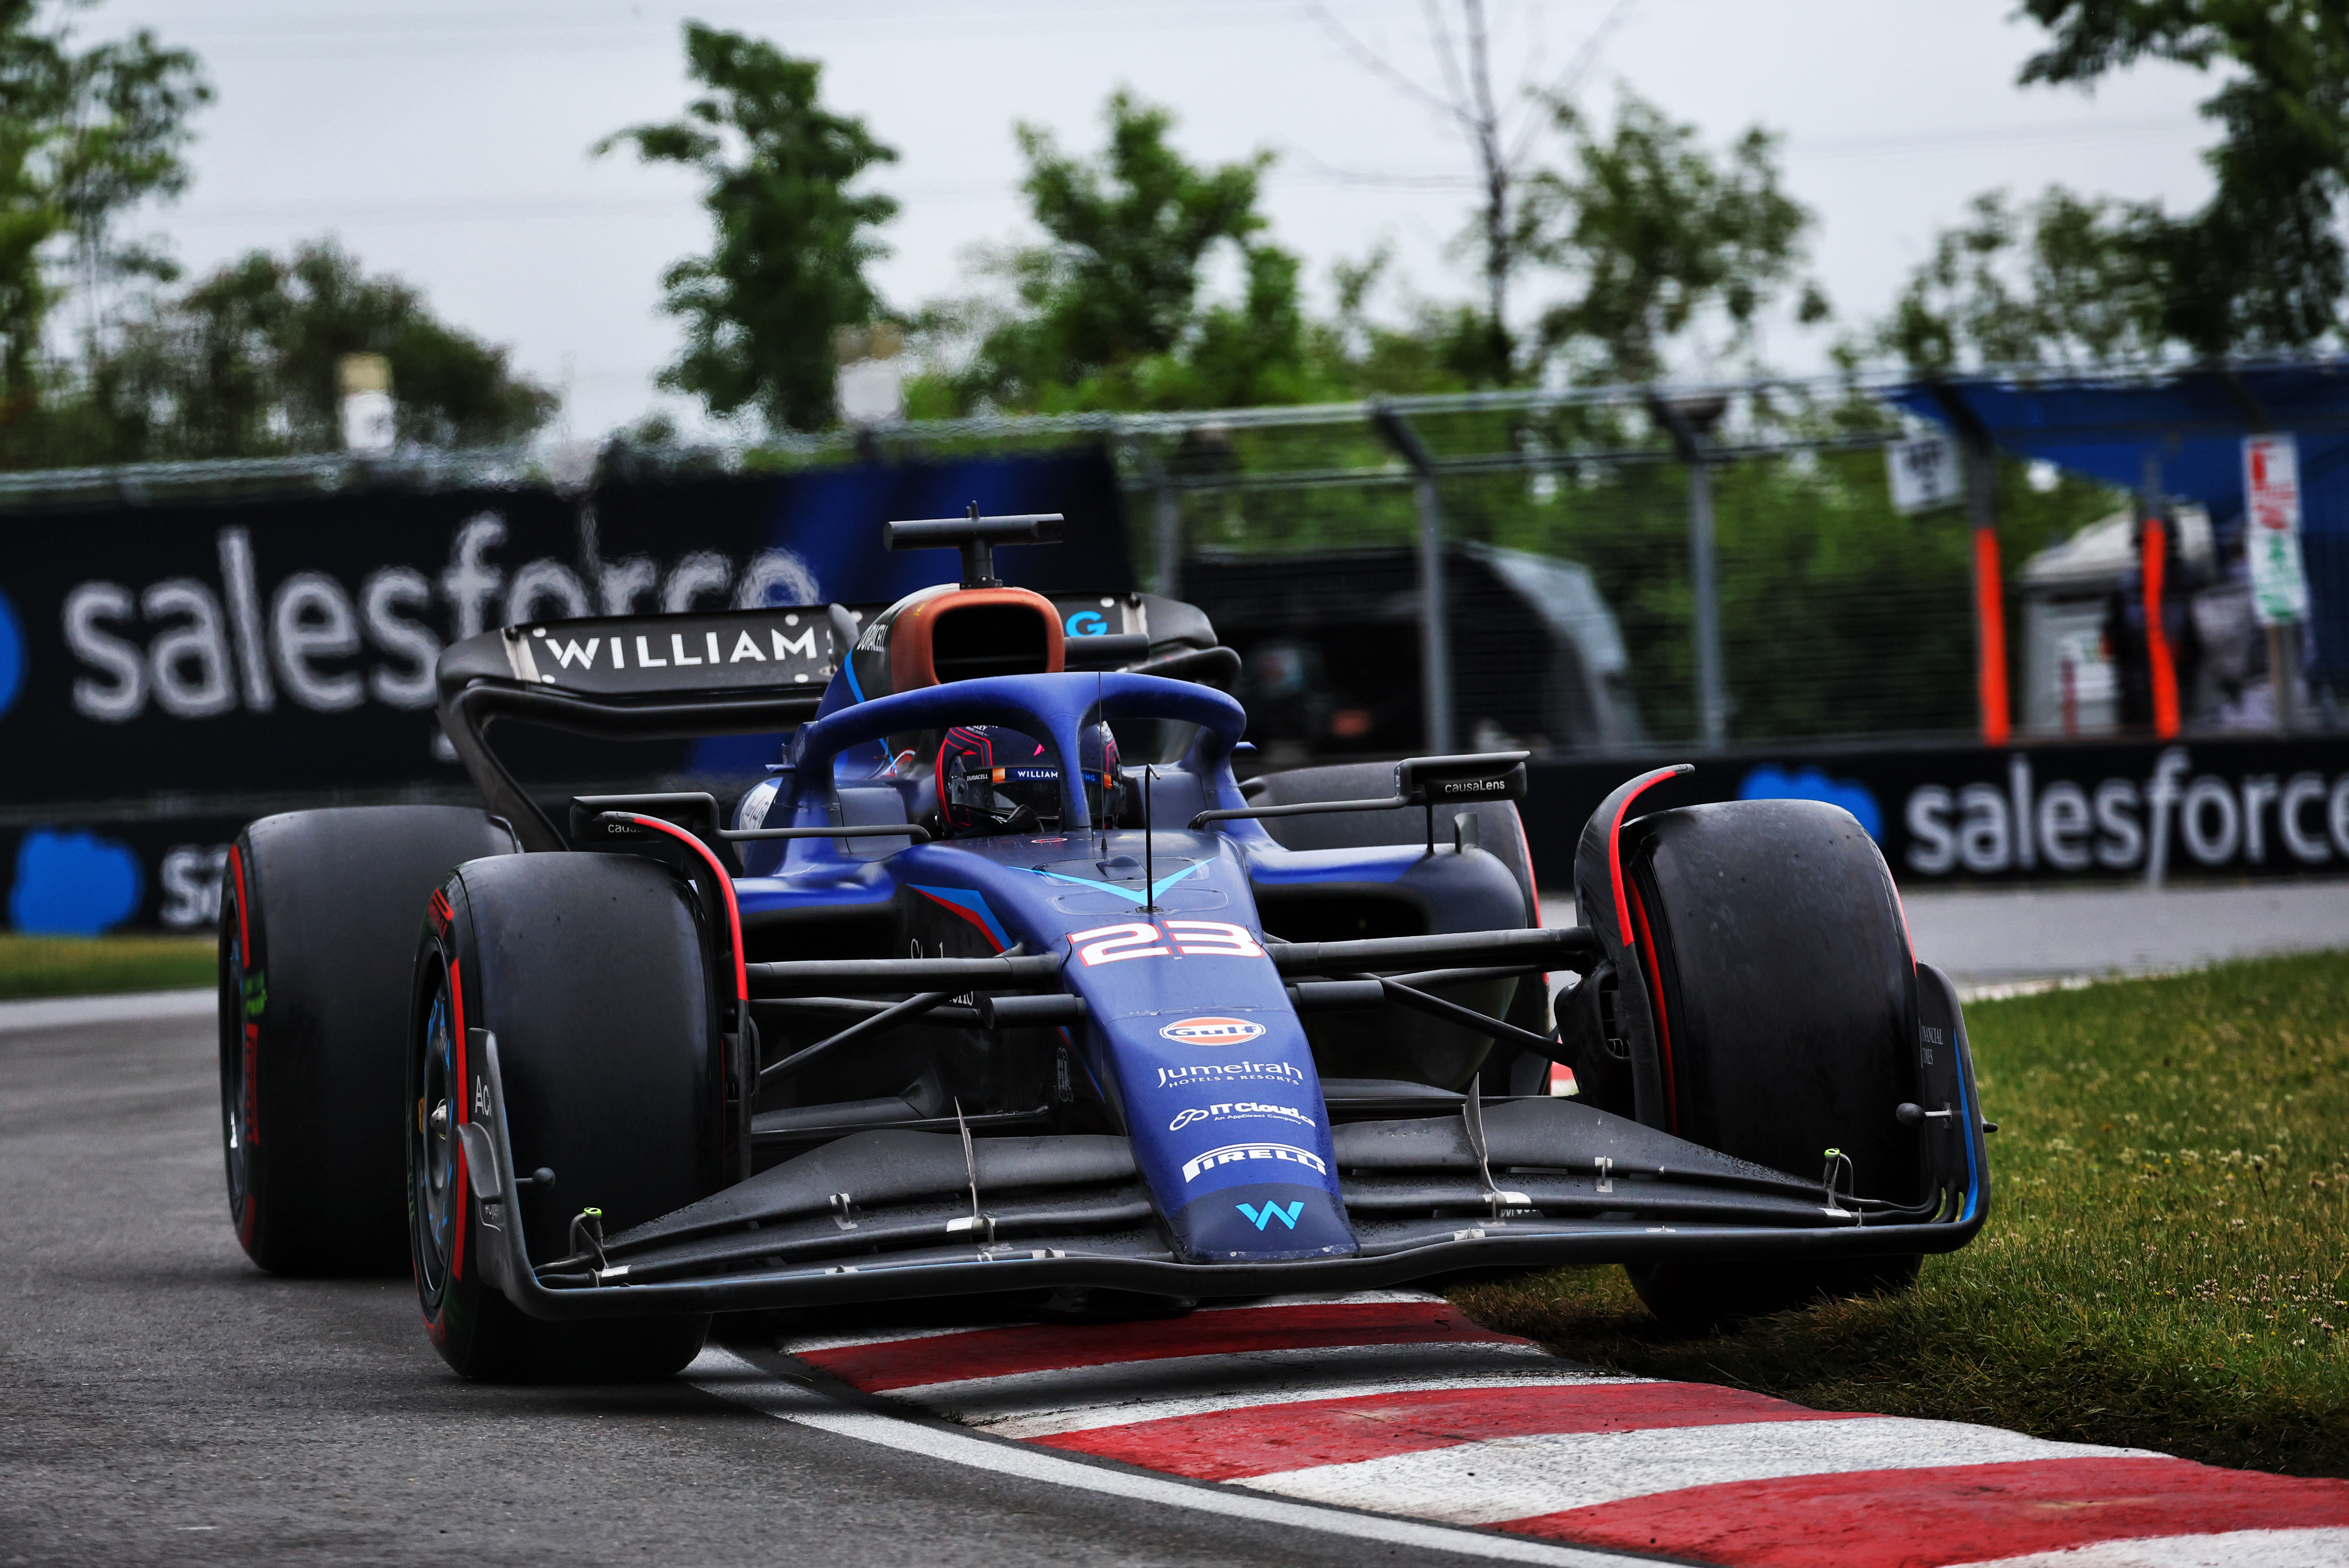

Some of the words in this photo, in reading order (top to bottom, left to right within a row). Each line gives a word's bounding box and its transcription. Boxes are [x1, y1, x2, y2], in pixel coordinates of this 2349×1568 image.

[545, 626, 833, 670] WILLIAM
[966, 773, 989, 782] DURACELL
[1445, 780, 1505, 793] causaLens
[1066, 920, 1266, 967] 23
[1167, 1026, 1259, 1036] Gulf
[1158, 1061, 1304, 1088] Jumeirah
[1169, 1076, 1221, 1088] HOTELS
[1240, 1075, 1299, 1086] RESORTS
[1267, 1114, 1302, 1125] Company
[1182, 1143, 1327, 1183] PIRELLI
